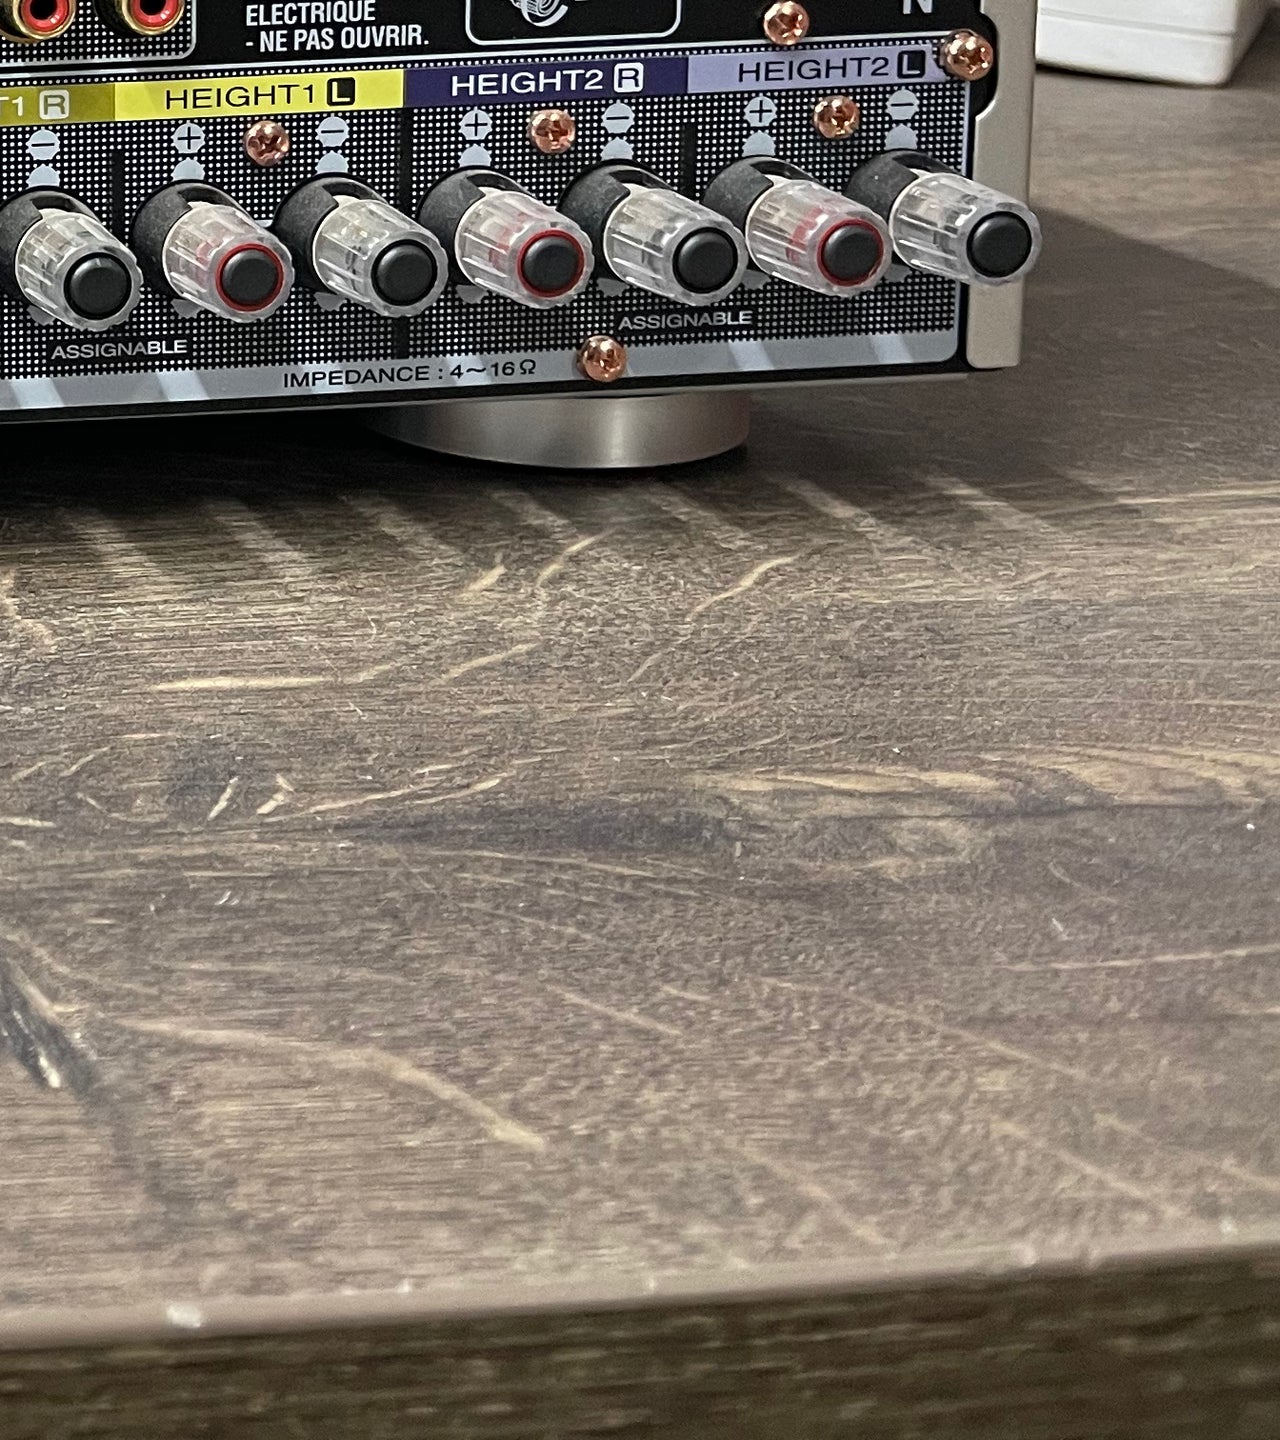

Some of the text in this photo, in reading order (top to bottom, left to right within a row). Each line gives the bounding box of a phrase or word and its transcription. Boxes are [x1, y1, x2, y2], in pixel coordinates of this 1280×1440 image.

[259, 23, 428, 52] NE PAS OUVRIR.
[739, 57, 889, 83] HEIGHT2
[451, 71, 602, 96] HEIGHT2
[165, 84, 315, 110] HEIGHT1
[618, 311, 752, 330] ASSIGNABLE
[51, 339, 187, 360] ASSIGNABLE
[283, 365, 430, 387] IMPEDANCE
